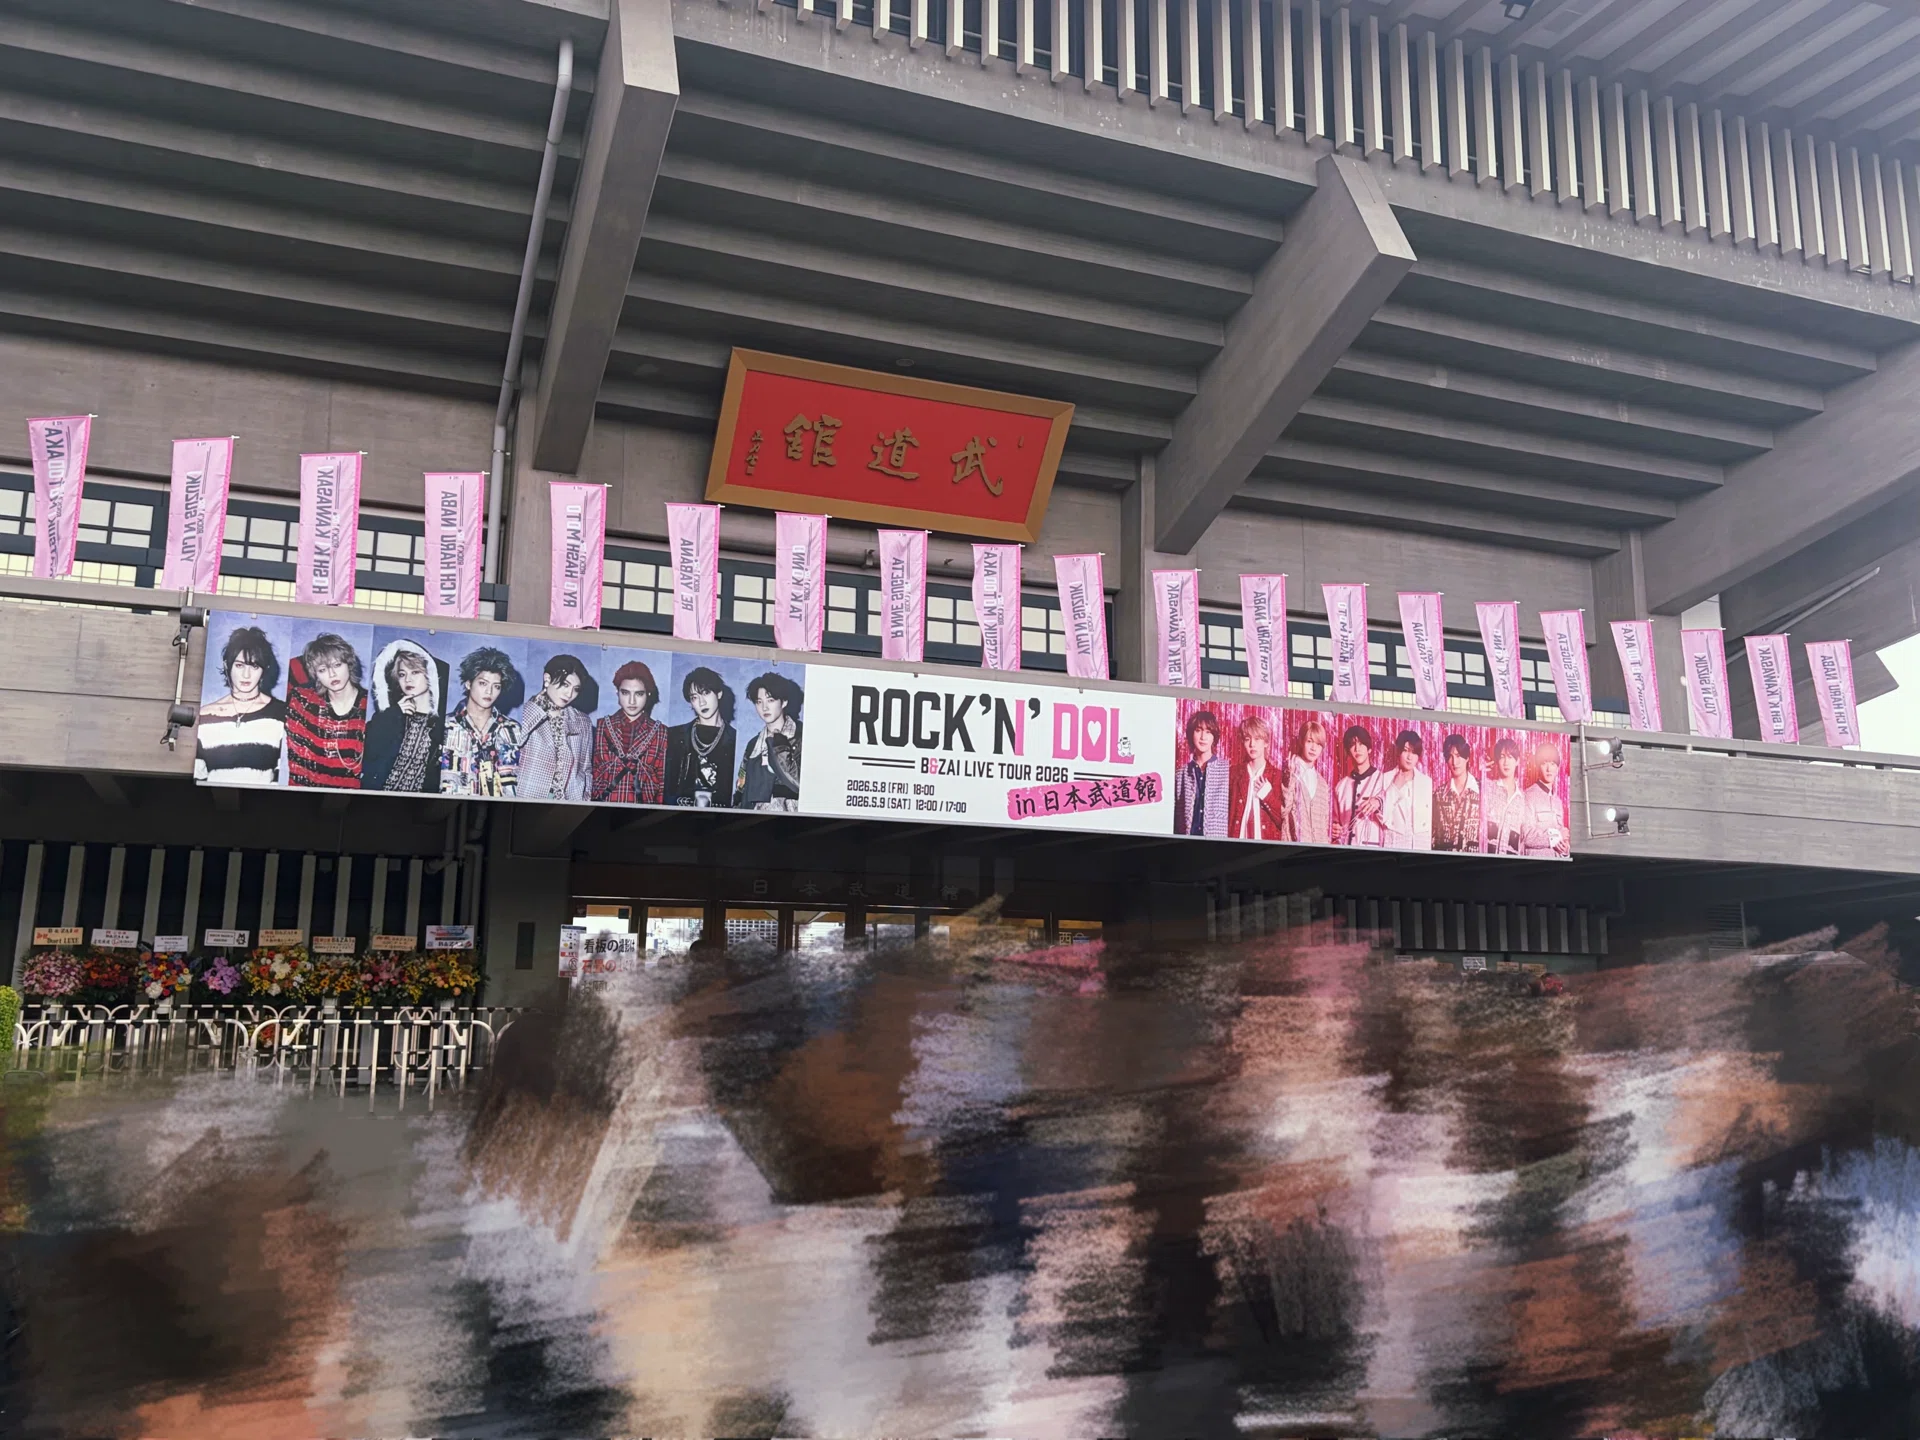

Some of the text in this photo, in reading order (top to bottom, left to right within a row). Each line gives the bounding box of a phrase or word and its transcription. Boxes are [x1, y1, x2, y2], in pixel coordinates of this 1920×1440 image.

[784, 413, 1004, 496] 武道館
[920, 757, 1069, 783] B&ZAI LIVE TOUR 2026
[846, 779, 886, 793] 2026.5.8
[913, 783, 935, 796] 18:00
[1015, 775, 1157, 816] in 日本武道館
[845, 795, 886, 810] 2026.5.9
[915, 799, 938, 812] 12:00
[945, 801, 967, 813] 17:00
[753, 879, 959, 901] 日本武道館
[1058, 931, 1073, 946] 西
